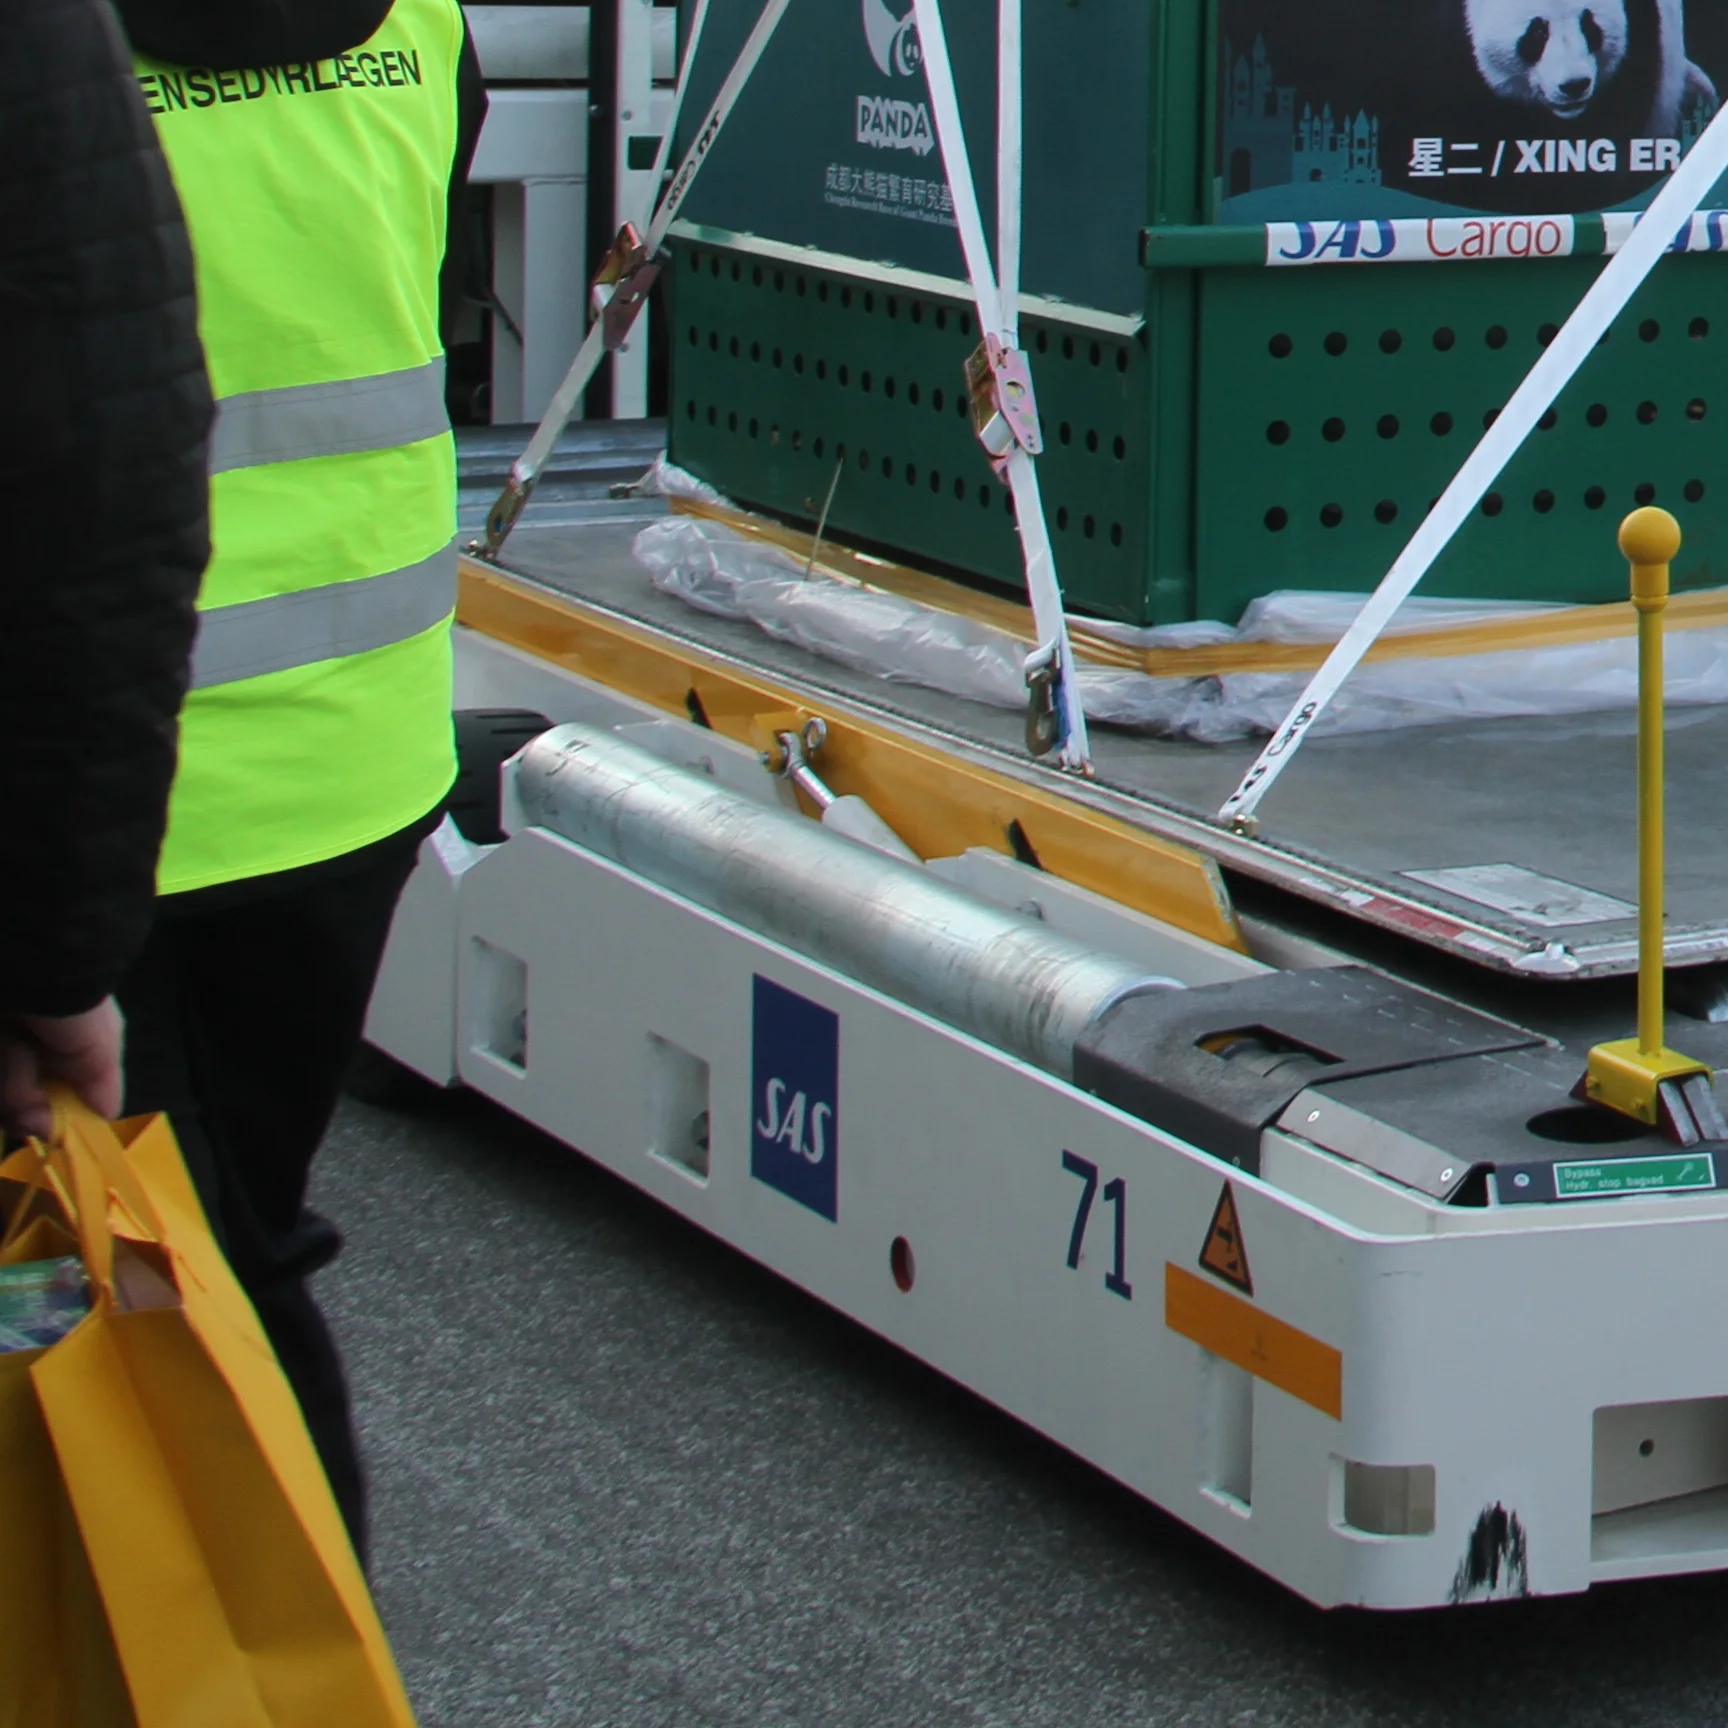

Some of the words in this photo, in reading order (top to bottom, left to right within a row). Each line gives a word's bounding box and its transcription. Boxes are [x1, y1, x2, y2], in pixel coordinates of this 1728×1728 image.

[857, 96, 935, 156] PANDA
[1408, 137, 1482, 177] 星二
[1513, 139, 1617, 173] XING
[1629, 138, 1682, 171] ER
[1426, 218, 1561, 258] Cargo
[1268, 702, 1317, 756] Cargo
[757, 1077, 832, 1164] SAS
[1564, 1168, 1602, 1179] Bypass
[1598, 1178, 1621, 1189] stop
[1626, 1175, 1664, 1187] bagved
[1062, 1149, 1132, 1301] 71
